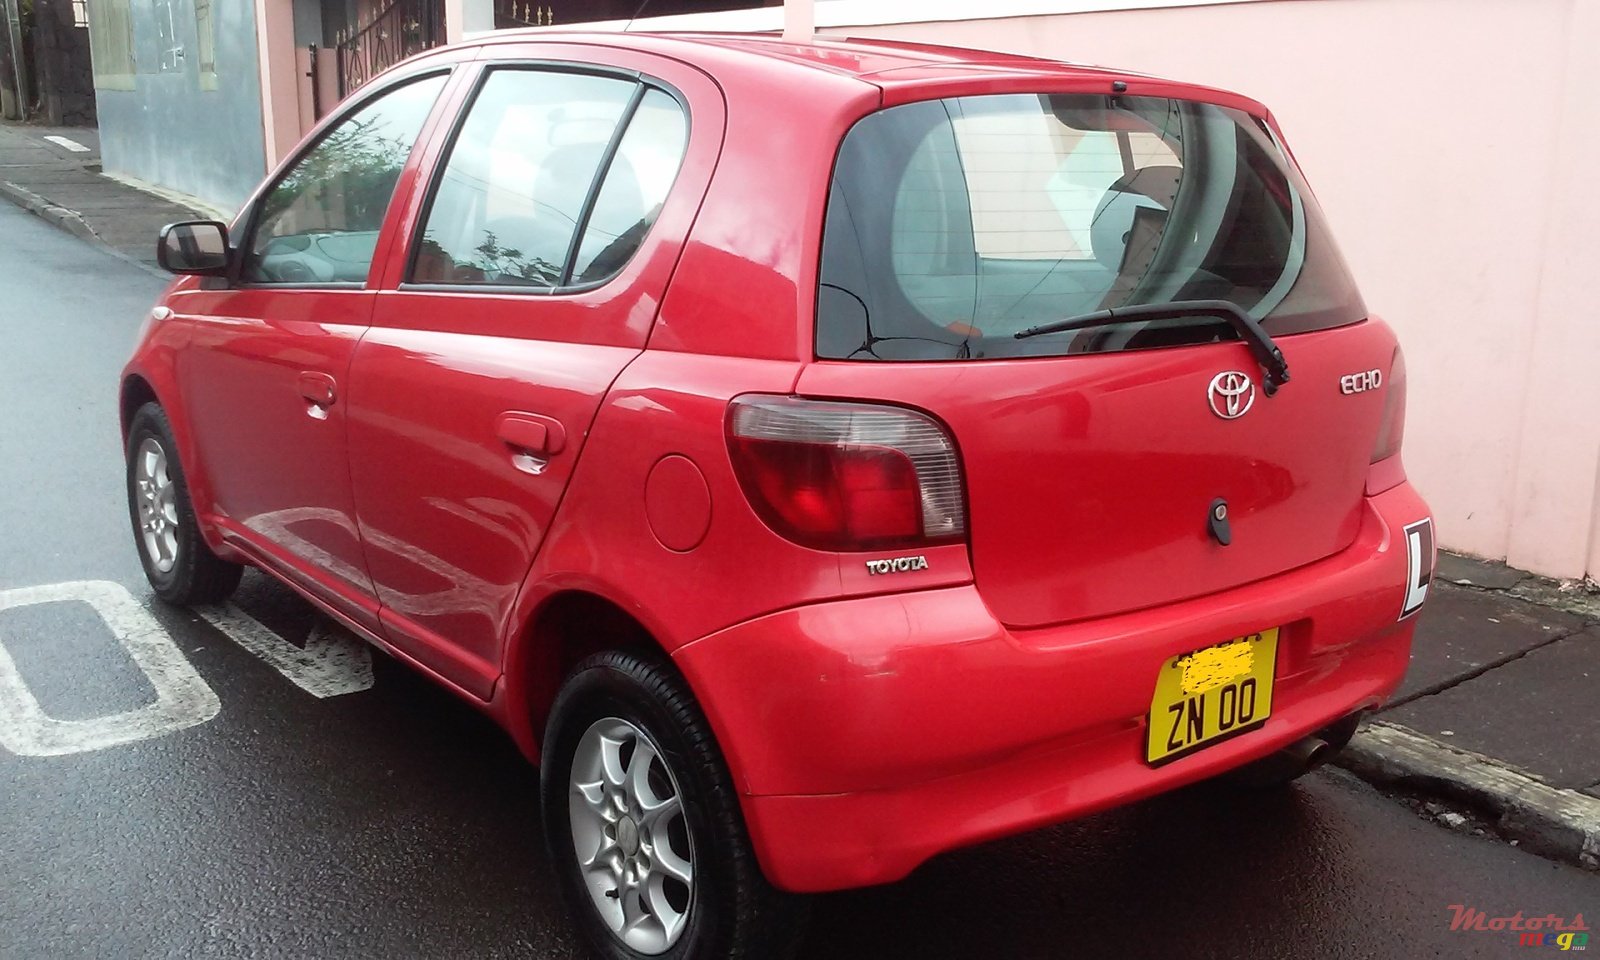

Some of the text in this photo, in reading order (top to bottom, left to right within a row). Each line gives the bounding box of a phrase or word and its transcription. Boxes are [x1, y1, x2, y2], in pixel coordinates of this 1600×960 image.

[1341, 369, 1382, 394] ECHO
[866, 556, 929, 575] TOYOTA
[1405, 531, 1429, 612] L
[1167, 694, 1205, 752] ZN
